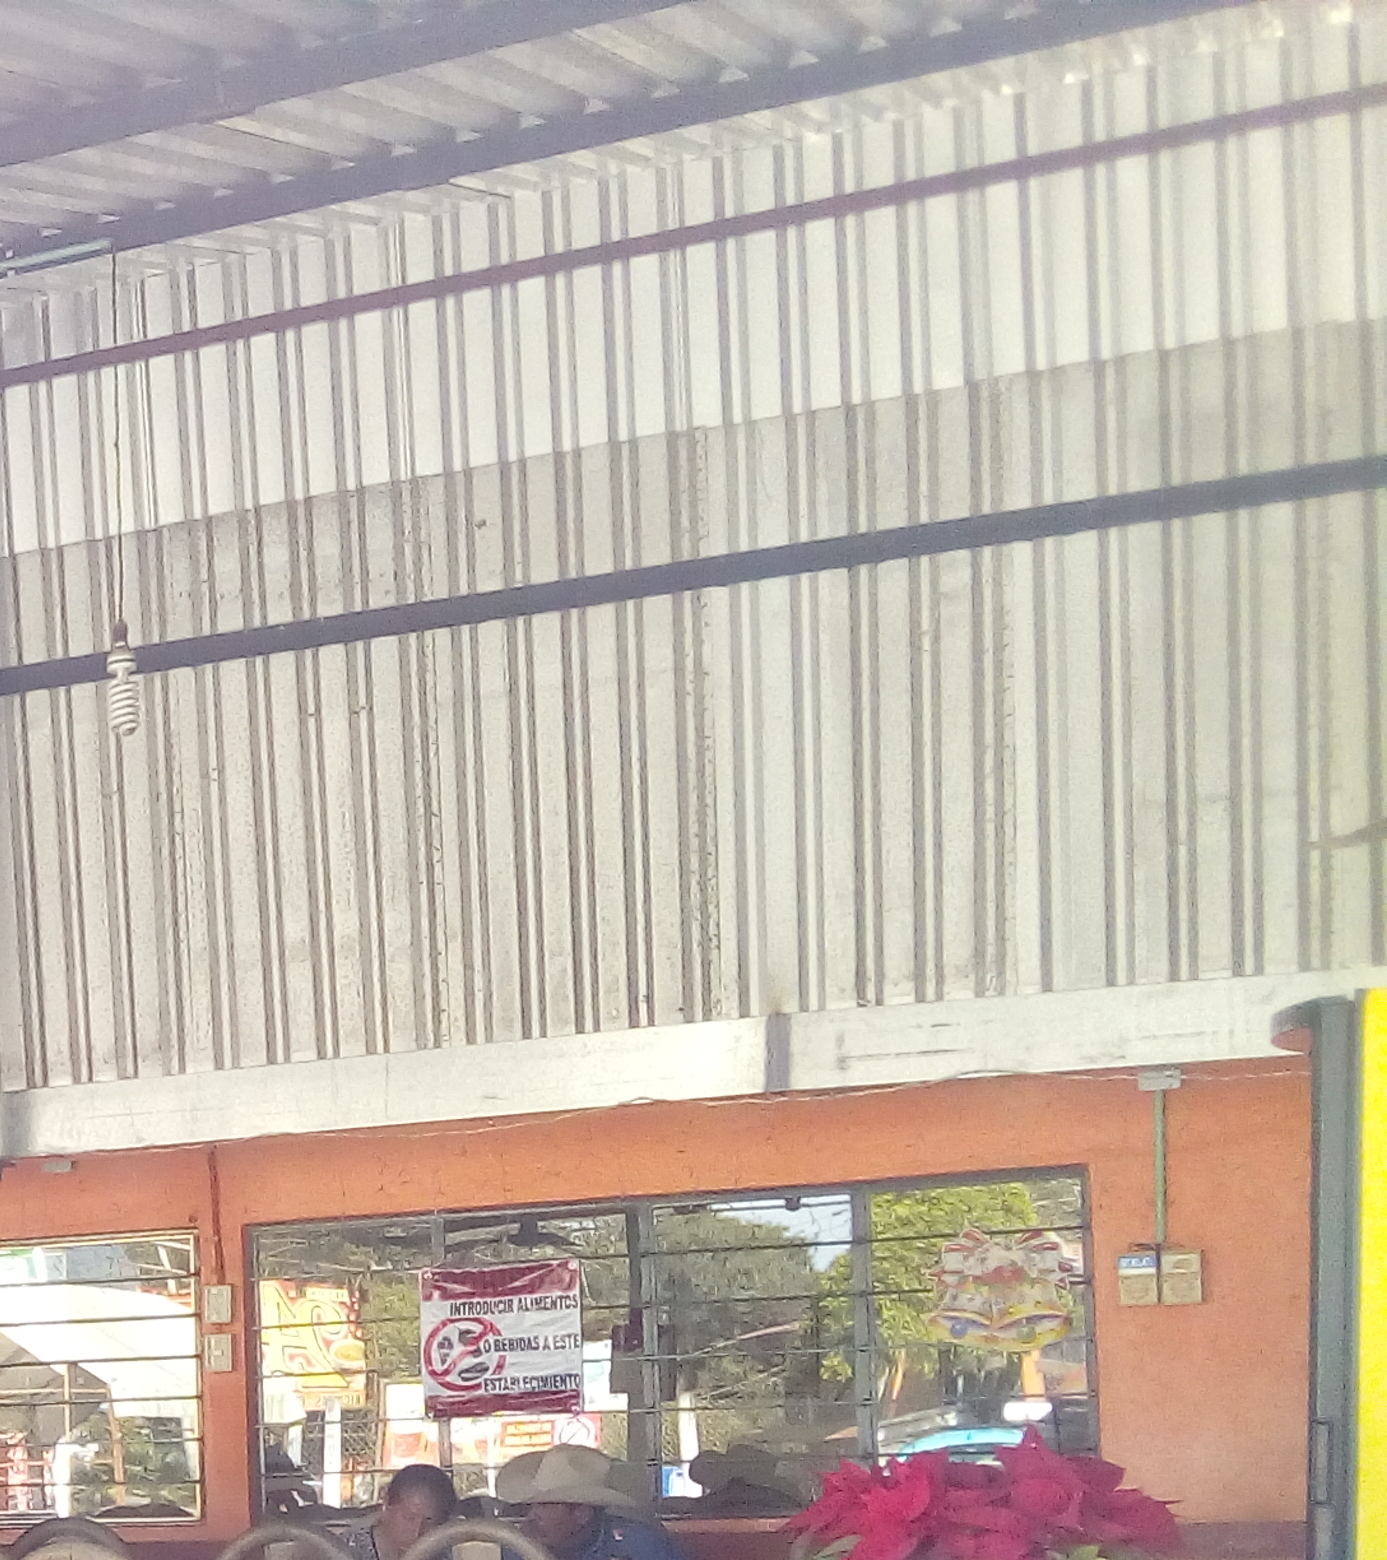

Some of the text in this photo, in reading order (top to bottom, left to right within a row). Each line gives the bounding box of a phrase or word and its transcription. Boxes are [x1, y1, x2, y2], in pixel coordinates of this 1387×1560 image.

[450, 1294, 578, 1316] INTRODUCIR ALIMENTOS
[483, 1333, 579, 1353] O BEBIDAS A ESTE
[483, 1374, 581, 1392] ESTABLECIMIENTO
